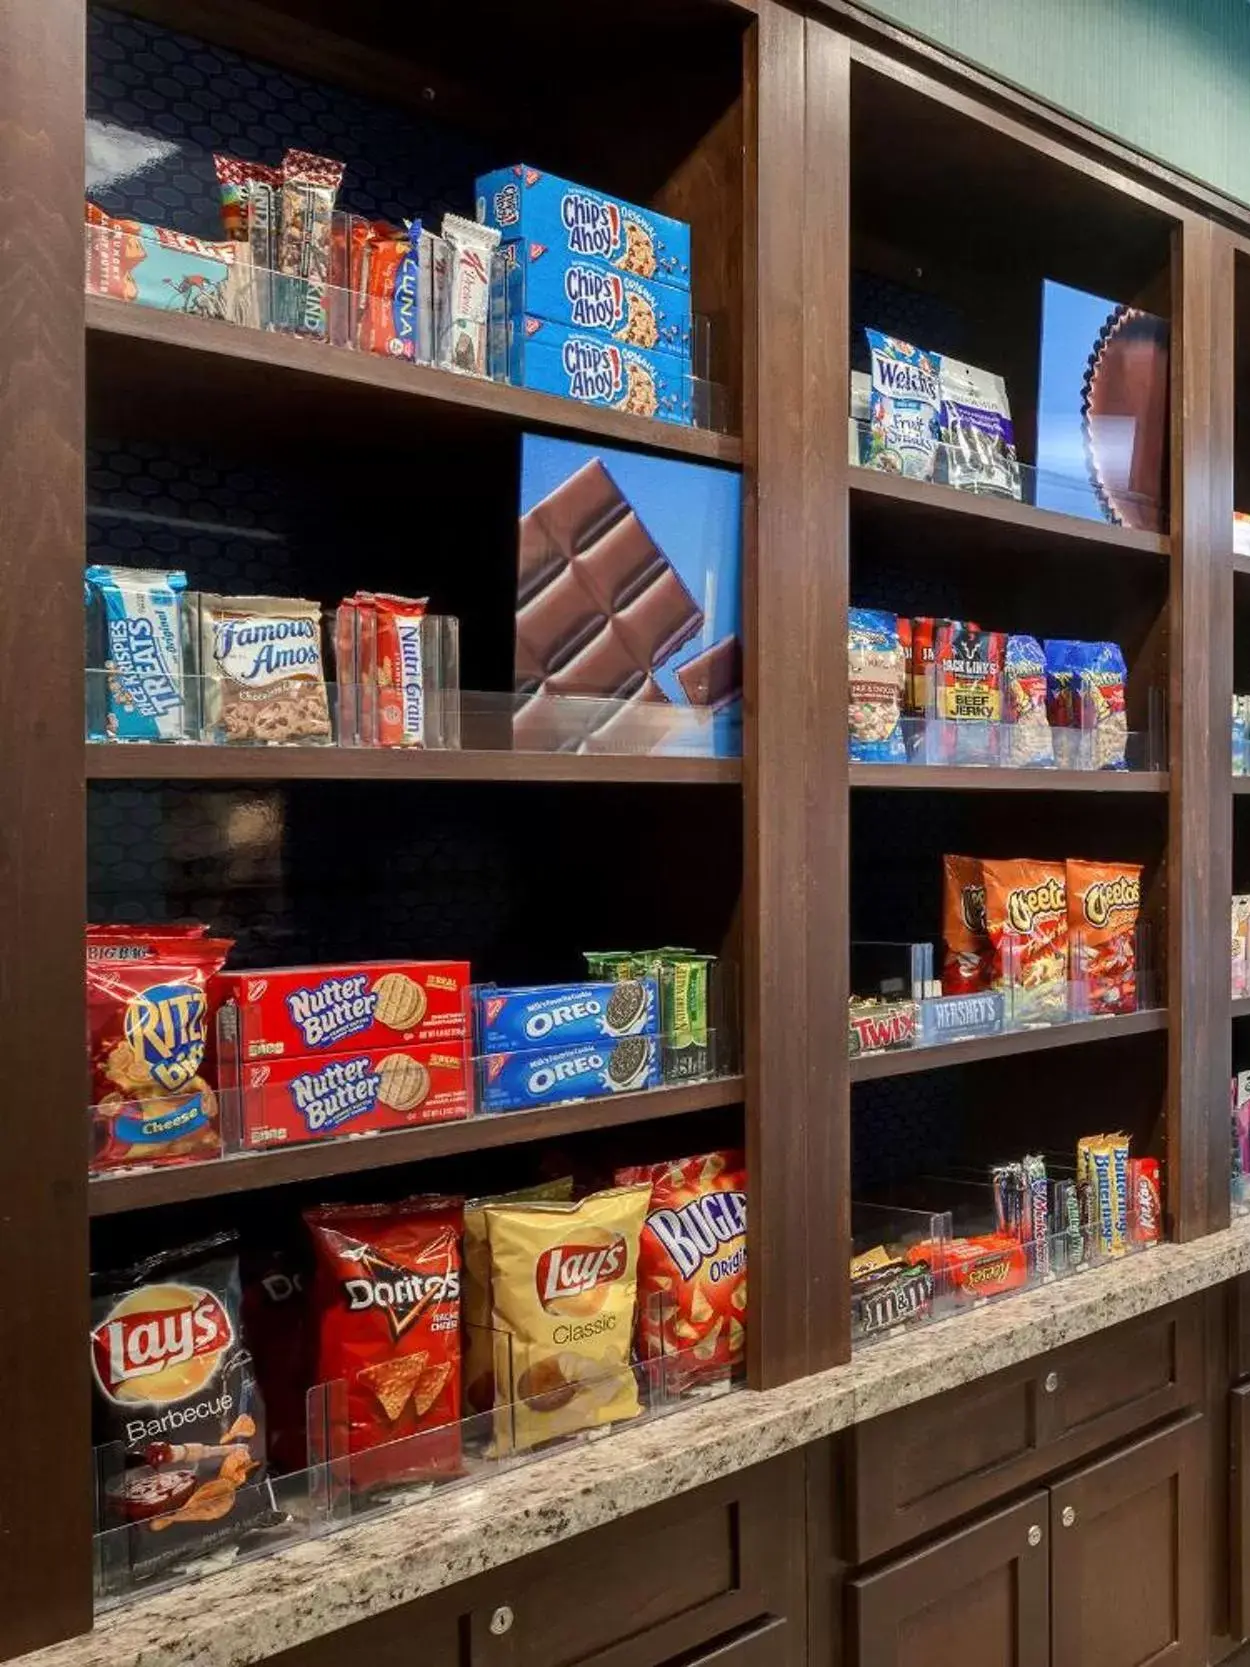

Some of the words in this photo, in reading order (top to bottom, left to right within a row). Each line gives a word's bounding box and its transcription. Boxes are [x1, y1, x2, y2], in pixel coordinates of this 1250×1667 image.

[562, 195, 609, 229] Chips
[570, 205, 619, 255] Ahoy!
[303, 282, 323, 329] KIND
[400, 258, 418, 336] LUNA
[566, 268, 612, 303] Chips
[573, 277, 621, 328] Ahoy!
[563, 343, 610, 374] Chips
[572, 349, 620, 399] Ahoy!
[213, 620, 316, 660] Famous
[240, 644, 320, 679] Amos
[128, 619, 182, 715] TREATS
[406, 683, 421, 733] Grain
[950, 706, 994, 717] JERKY
[956, 695, 989, 706] BEEF
[289, 976, 366, 1022] Nutter
[301, 993, 376, 1045] Butter
[525, 1000, 601, 1037] OREO
[935, 998, 996, 1029] HERSHEY'S
[128, 993, 207, 1062] RITZ
[291, 1058, 369, 1108] Nutter
[528, 1054, 604, 1093] OREO
[142, 1107, 199, 1136] Cheese
[304, 1075, 381, 1130] Butter
[345, 1270, 460, 1310] Doritos
[552, 1312, 616, 1345] Classic
[125, 1392, 233, 1443] Barbecue
